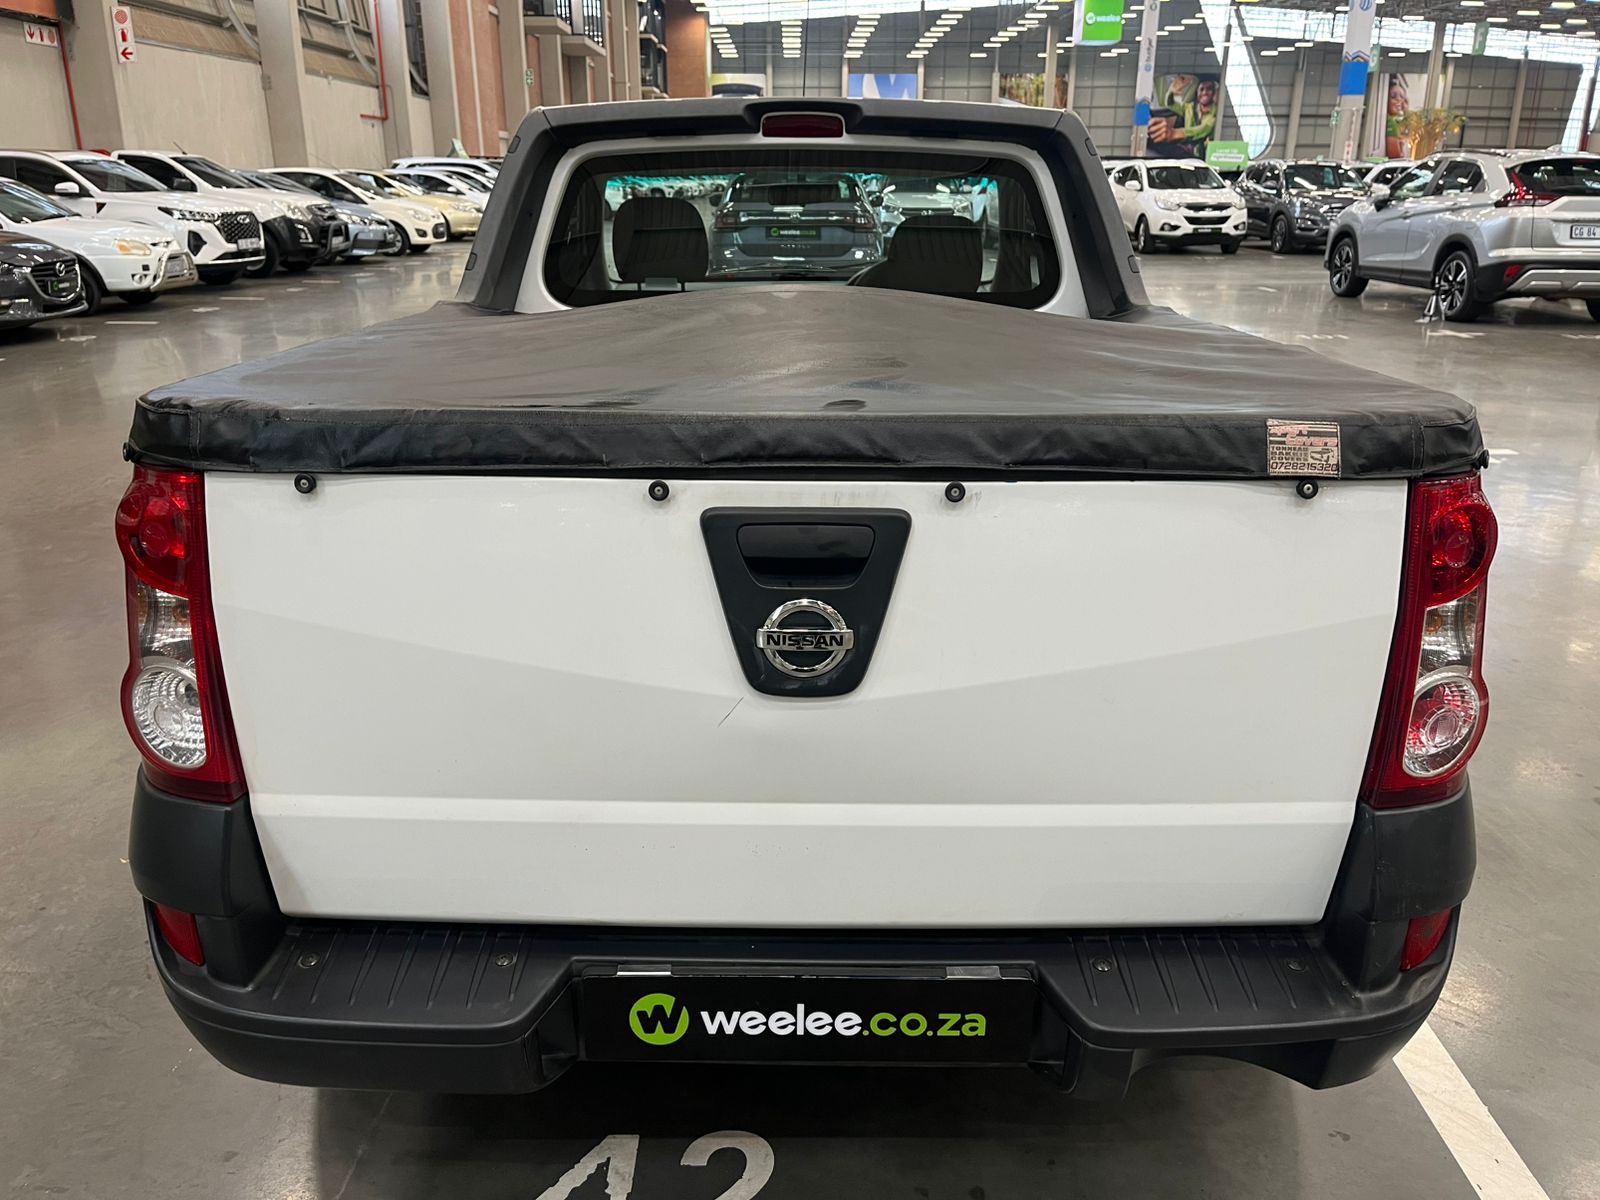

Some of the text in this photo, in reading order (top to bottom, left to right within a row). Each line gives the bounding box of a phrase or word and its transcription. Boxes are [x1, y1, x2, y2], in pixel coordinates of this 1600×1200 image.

[1271, 461, 1338, 471] 0728215320
[766, 634, 844, 647] NISSAN
[700, 1003, 987, 1037] weelee.co.za
